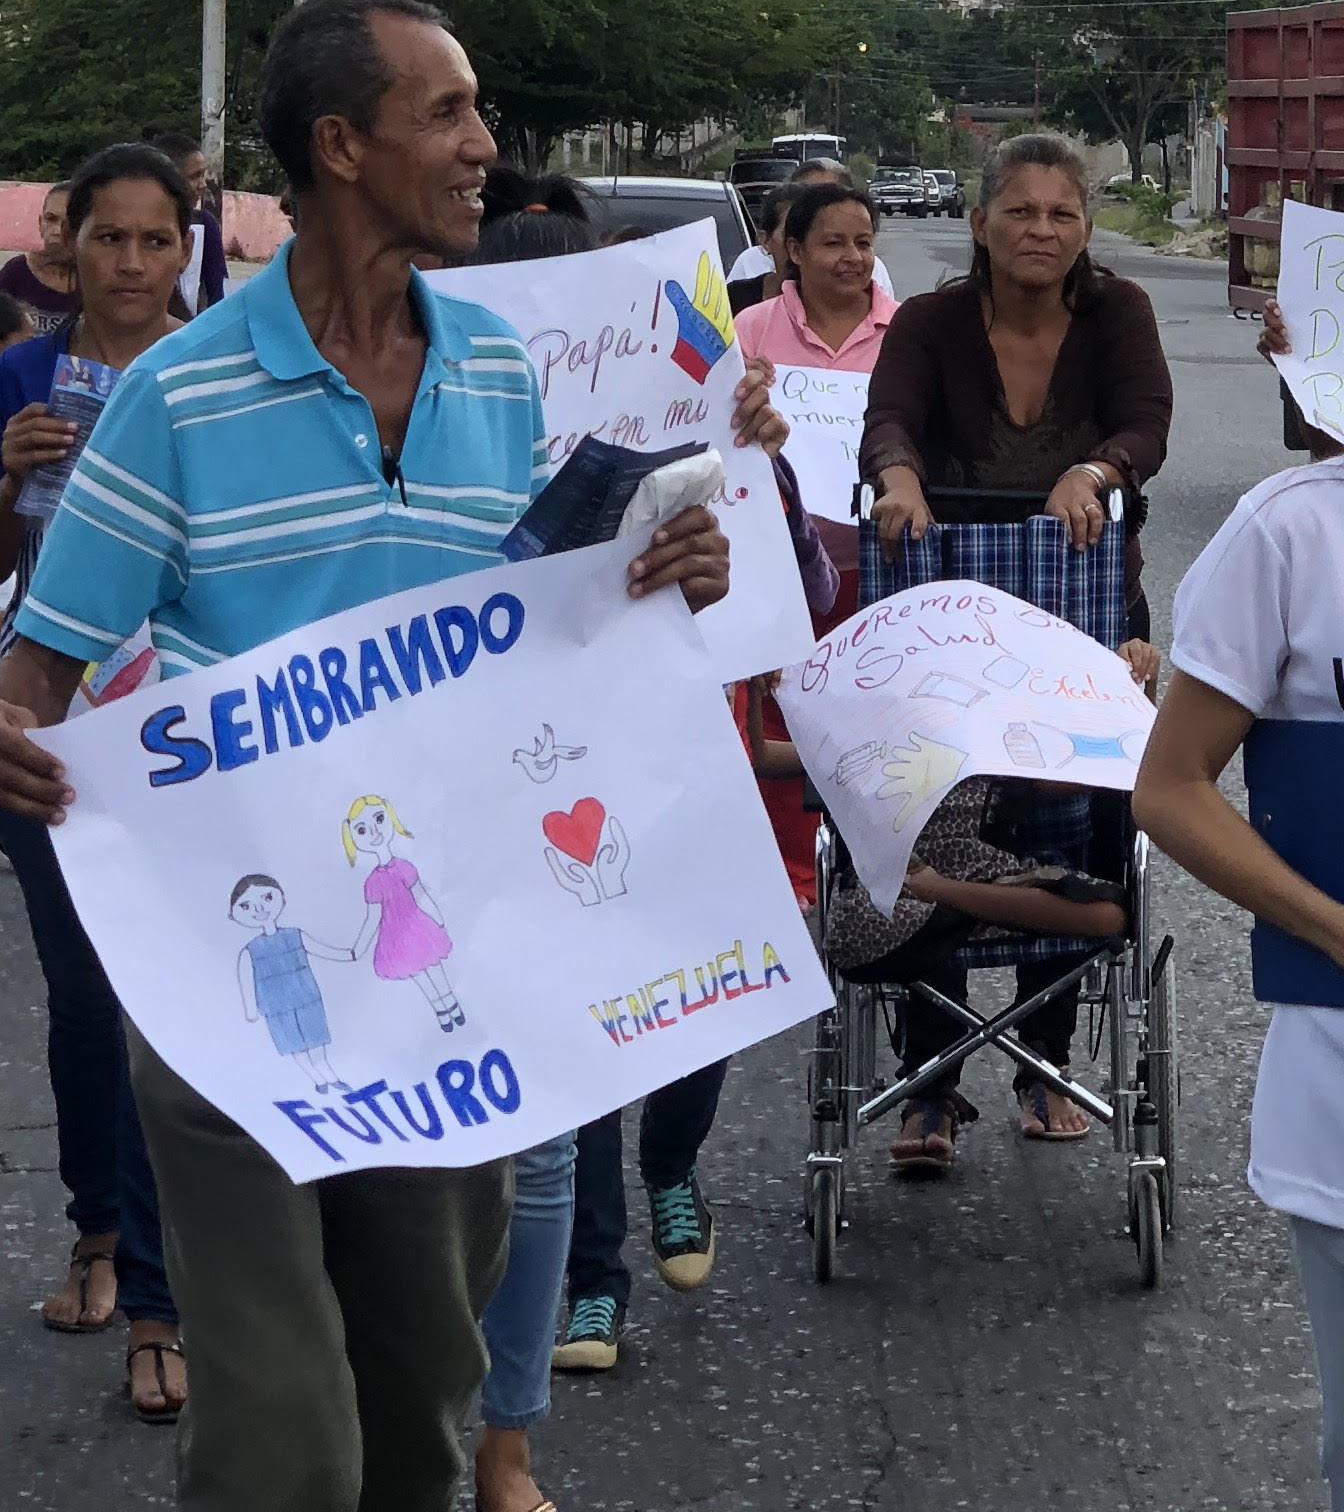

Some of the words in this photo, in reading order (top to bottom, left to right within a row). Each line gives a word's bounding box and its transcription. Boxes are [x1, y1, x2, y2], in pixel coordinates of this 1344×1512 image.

[782, 370, 840, 404] Que
[140, 592, 526, 788] SEMBRANDO
[589, 939, 792, 1048] VENEZUELA
[273, 1048, 522, 1163] FUTURO
